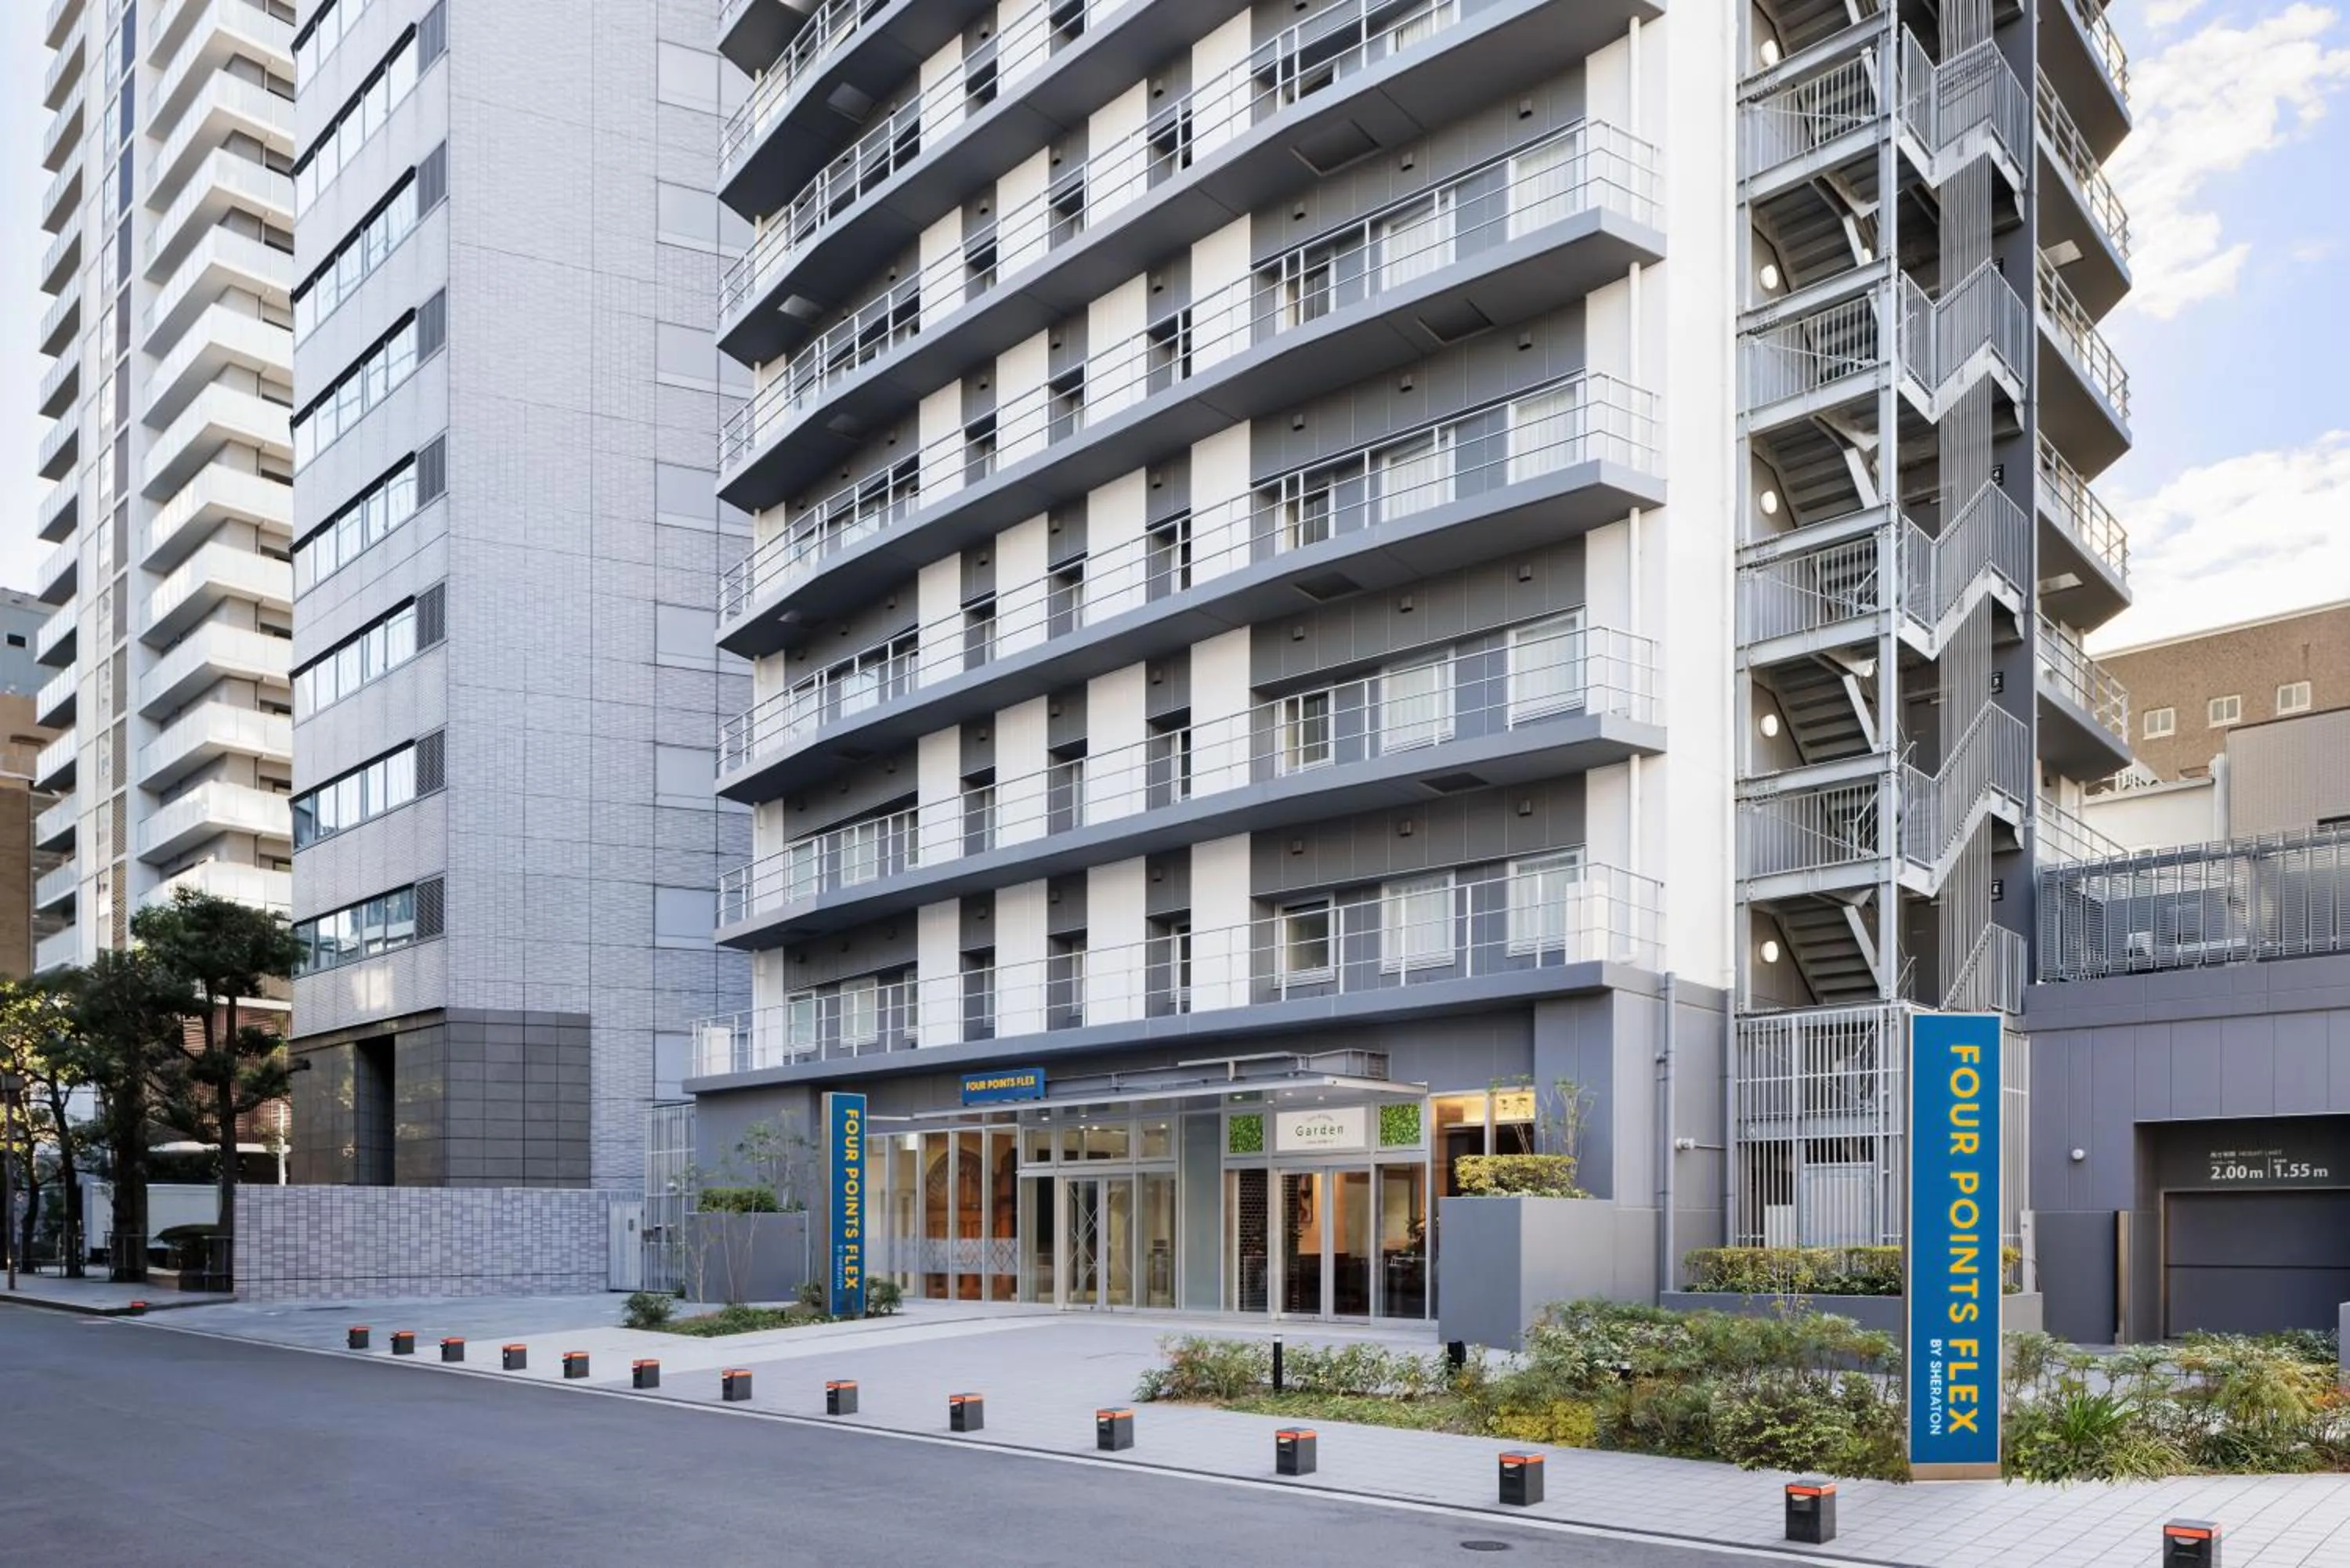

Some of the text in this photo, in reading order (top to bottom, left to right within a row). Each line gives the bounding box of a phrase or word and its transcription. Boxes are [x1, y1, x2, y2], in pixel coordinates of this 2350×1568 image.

[966, 1075, 1035, 1091] FOUR POINTS FLEX
[1295, 1124, 1344, 1137] Garden
[844, 1109, 859, 1289] FOUR POINTS FLEX
[1947, 1045, 1980, 1433] FOUR POINTS FLEX
[1929, 1339, 1943, 1436] BY SHERATON
